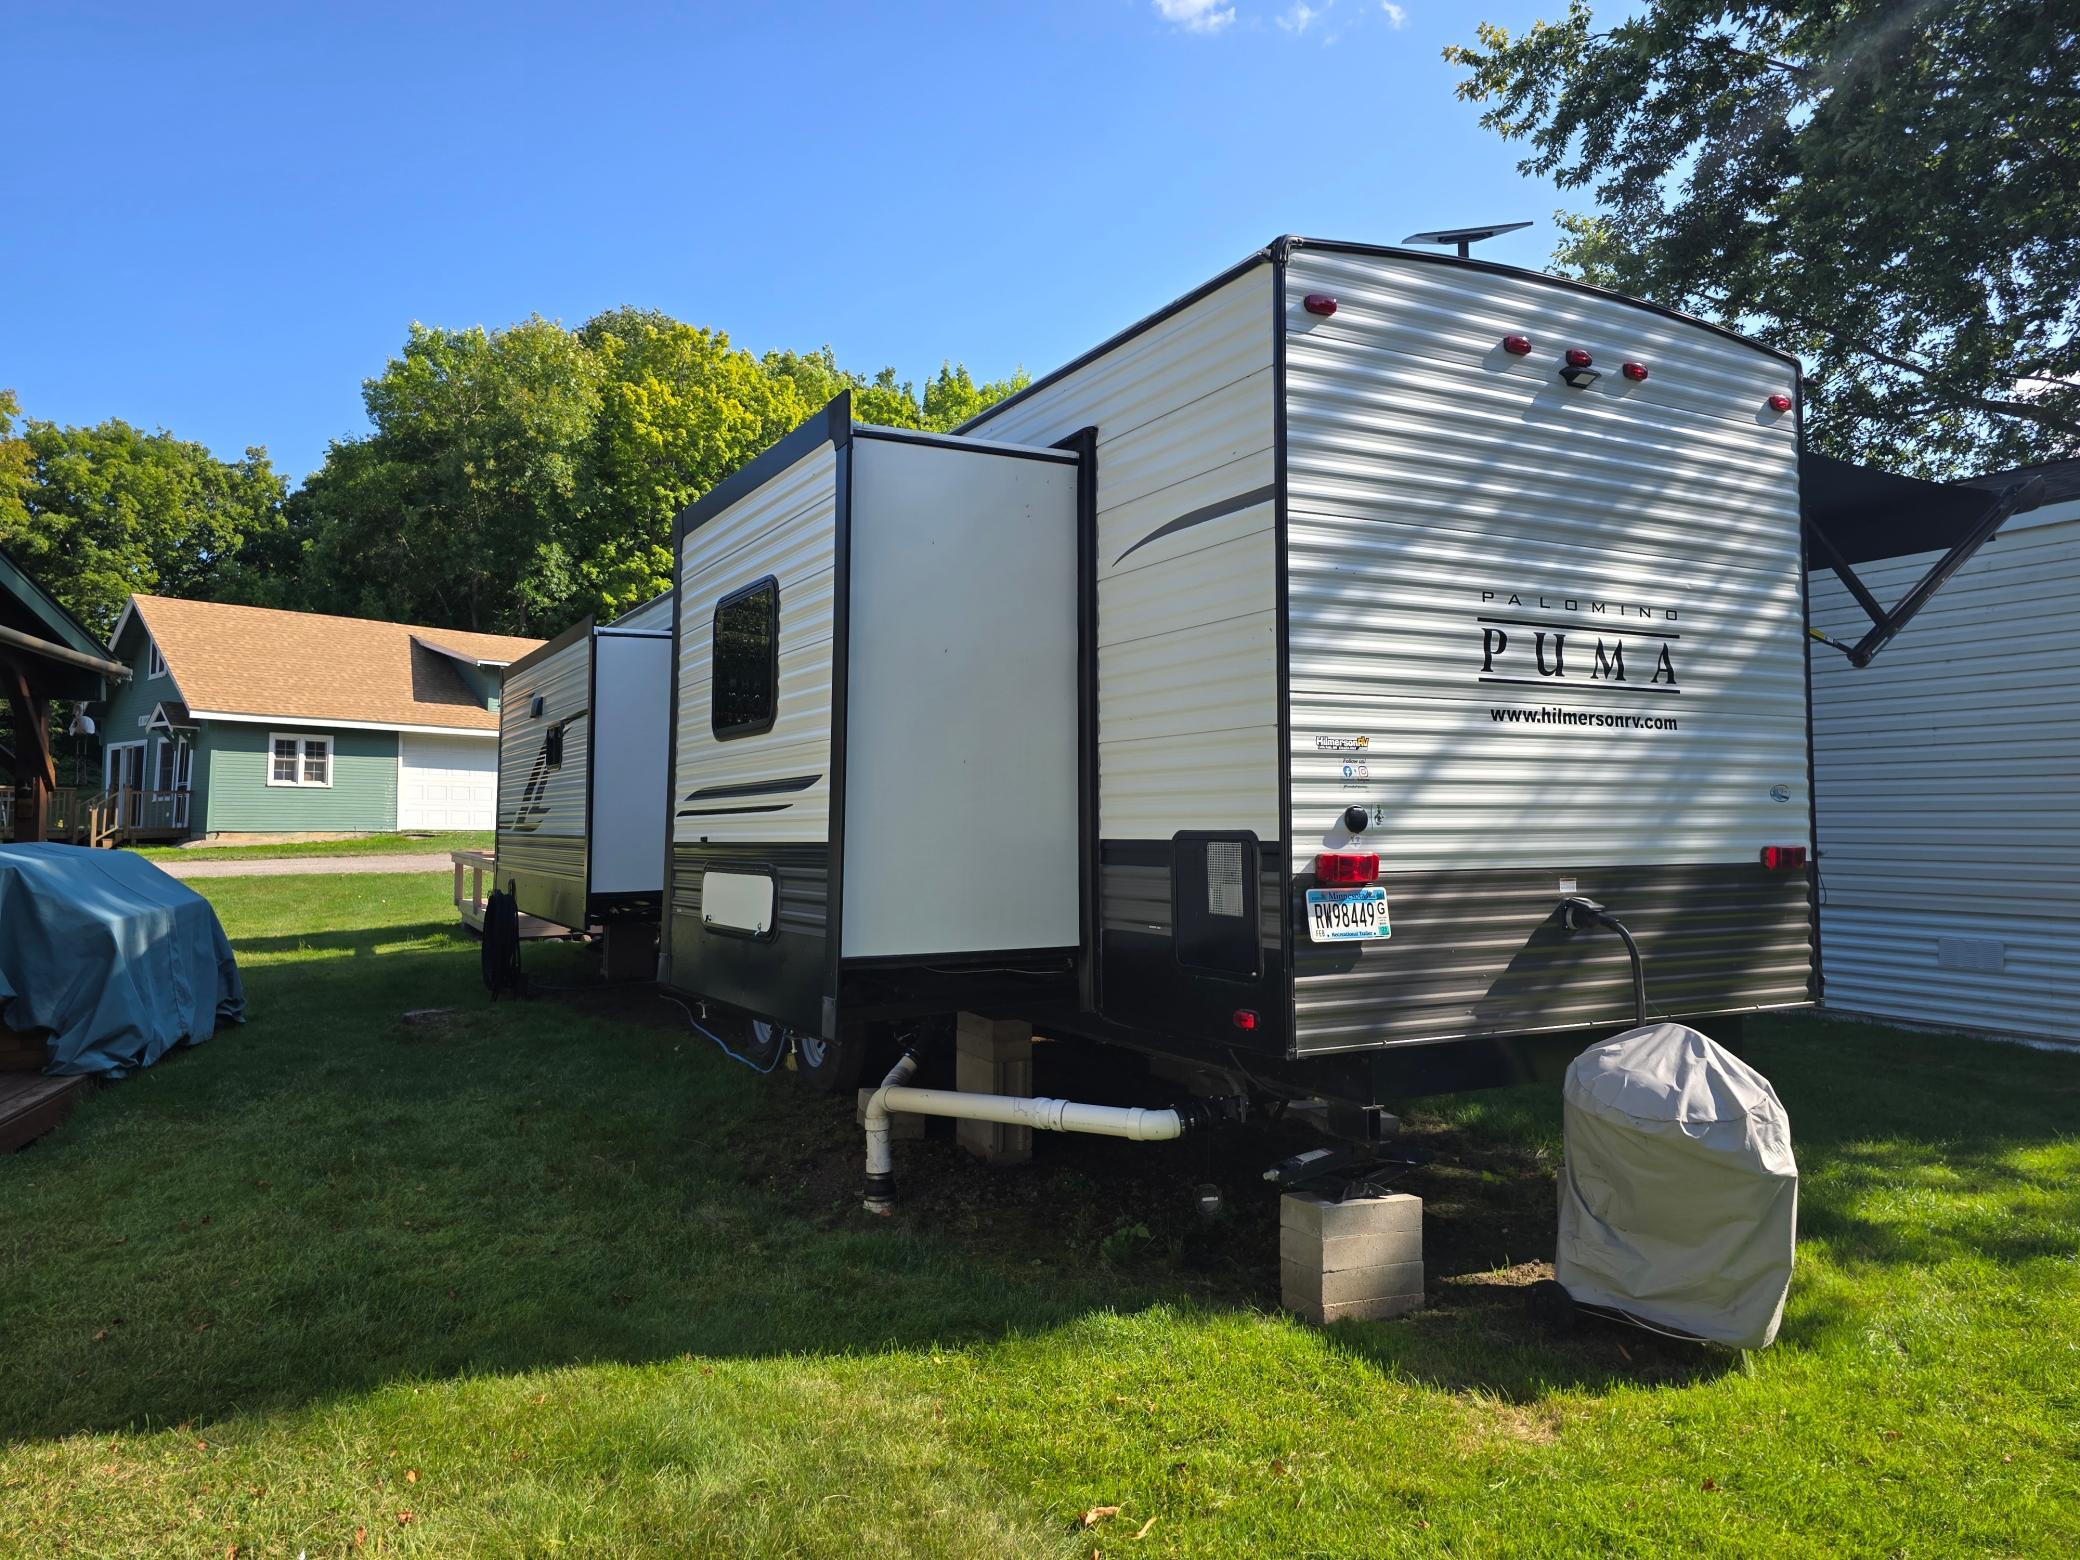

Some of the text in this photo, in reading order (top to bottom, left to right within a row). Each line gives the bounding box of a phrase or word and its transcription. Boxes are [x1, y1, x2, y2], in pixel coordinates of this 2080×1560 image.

[1482, 591, 1678, 621] PALOMINO
[1481, 627, 1677, 684] PUMA
[1490, 707, 1678, 730] www.hilmersonrv.com
[1328, 891, 1370, 900] Minnesota
[1314, 902, 1374, 928] RW98449
[1377, 902, 1385, 914] G
